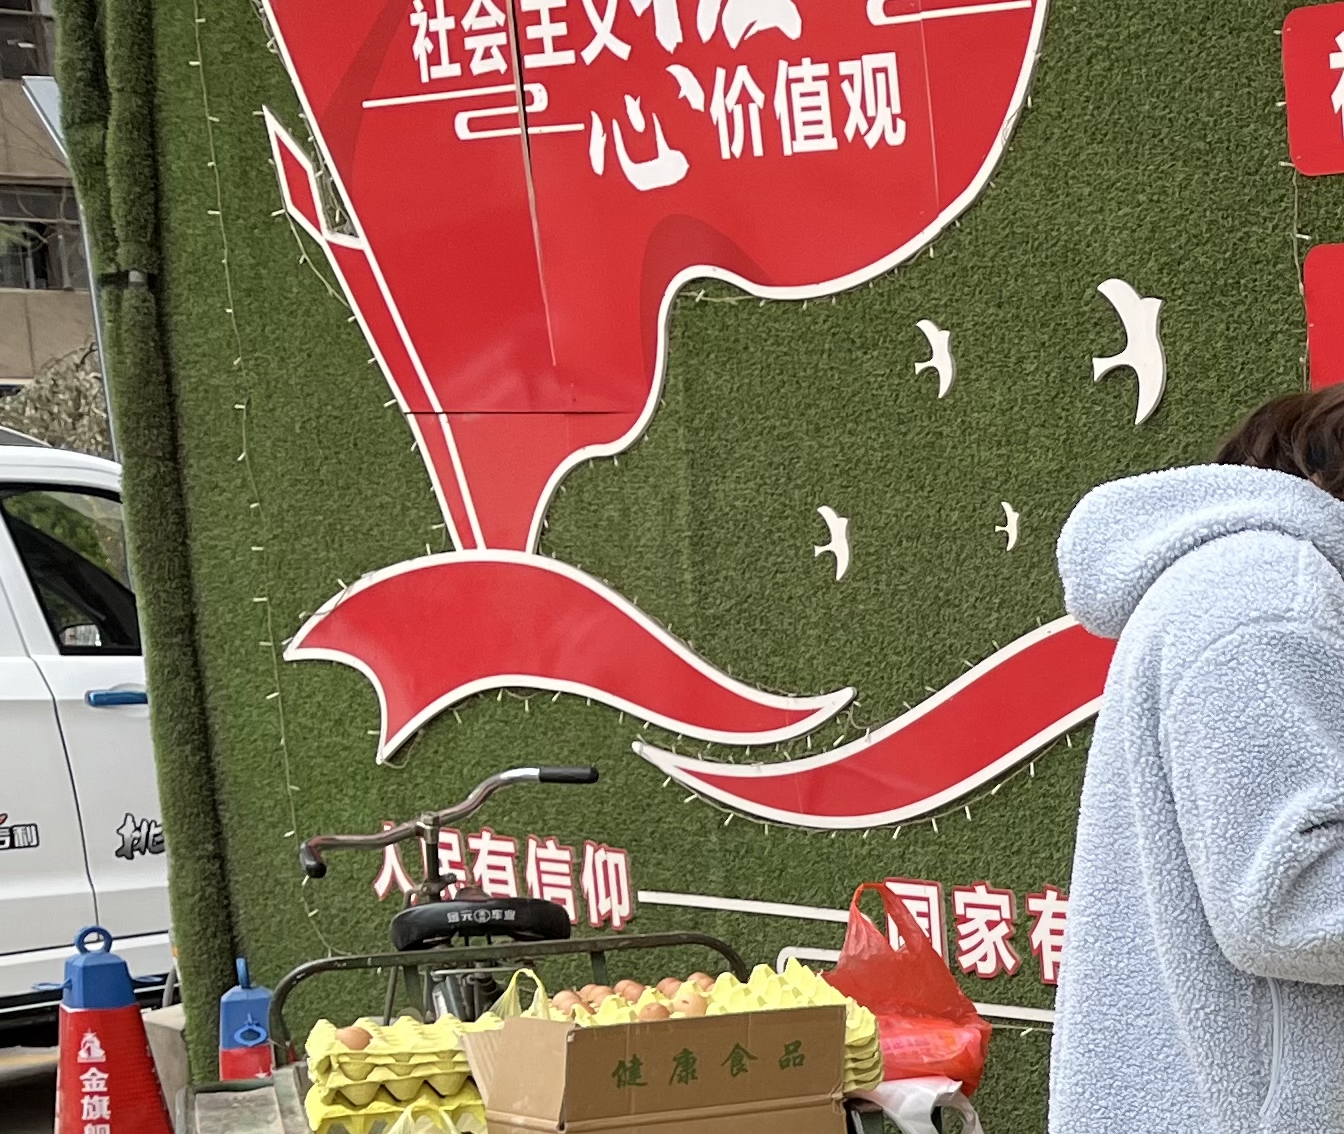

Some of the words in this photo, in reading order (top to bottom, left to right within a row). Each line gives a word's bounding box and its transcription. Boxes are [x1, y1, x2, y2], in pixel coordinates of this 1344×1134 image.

[410, 0, 631, 84] 社会主义
[710, 52, 906, 160] 价值观
[612, 1040, 806, 1088] 健康食品
